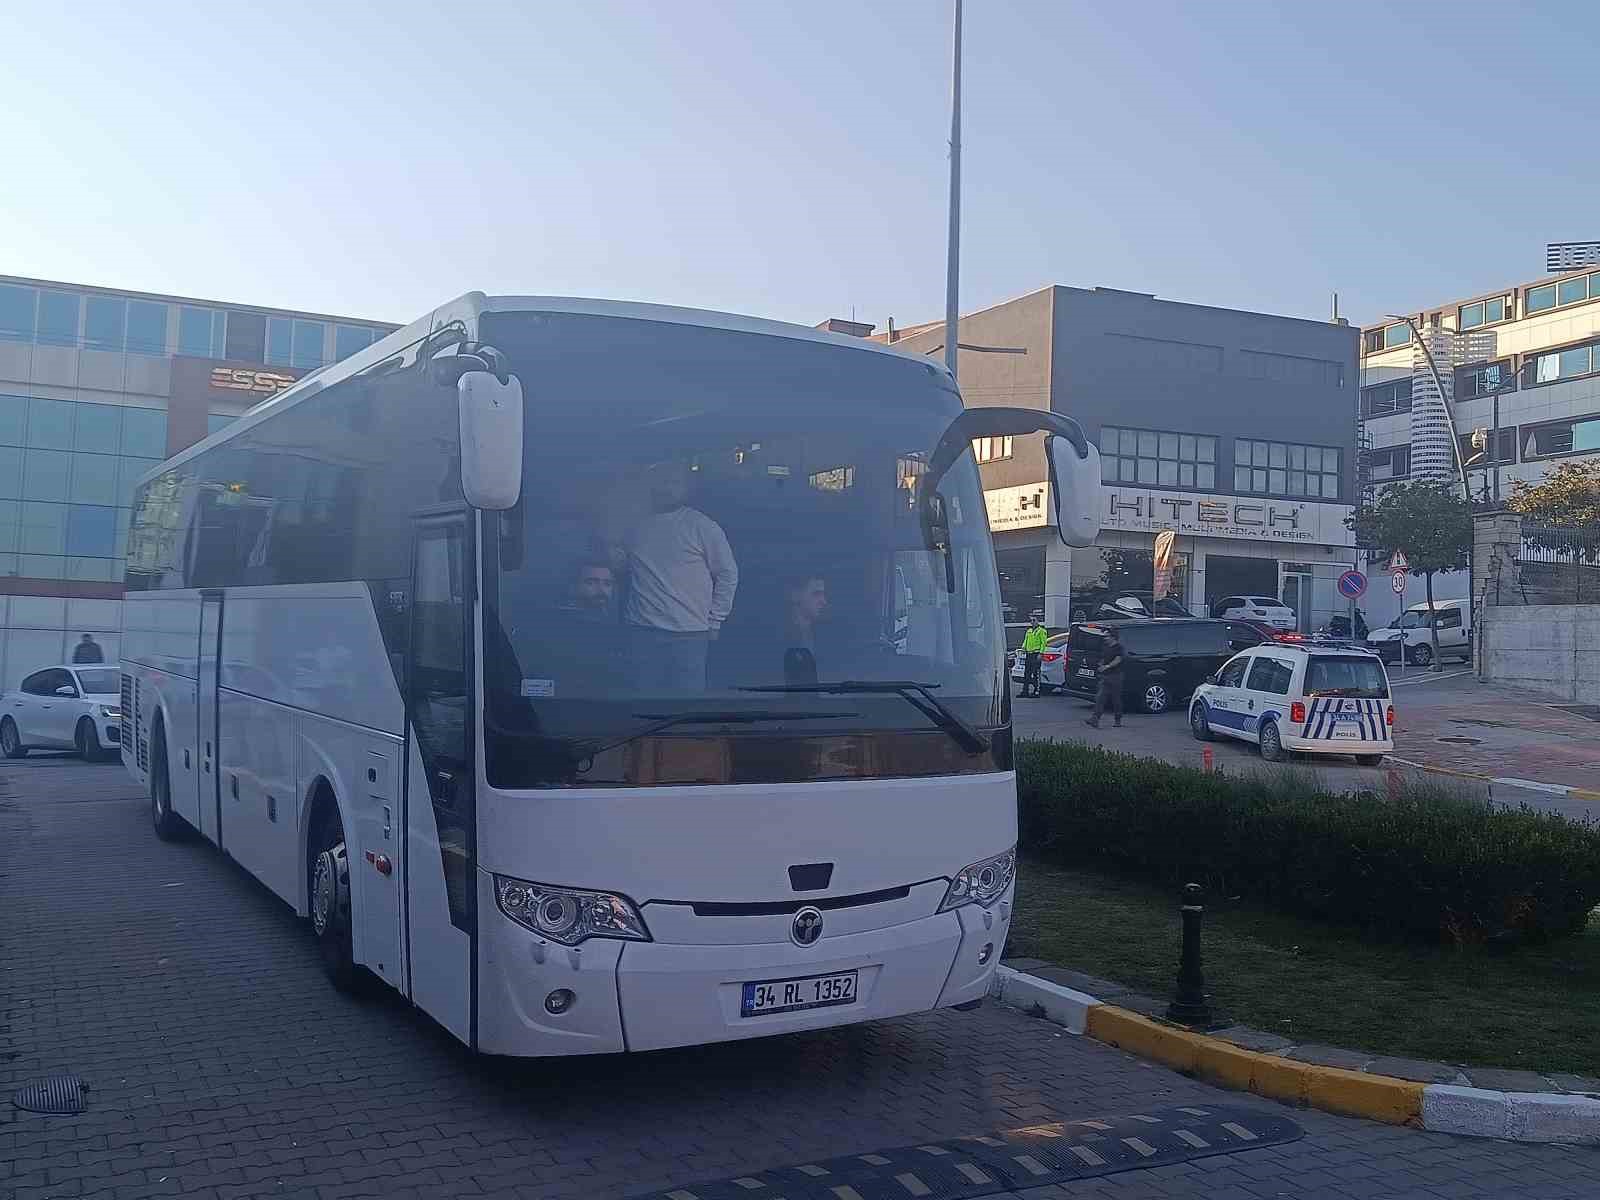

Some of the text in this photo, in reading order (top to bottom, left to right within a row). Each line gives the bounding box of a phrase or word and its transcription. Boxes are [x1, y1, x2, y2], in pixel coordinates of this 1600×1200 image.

[1110, 494, 1299, 528] HITECH
[1393, 576, 1403, 588] 30
[755, 977, 852, 1007] 34 RL 1352
